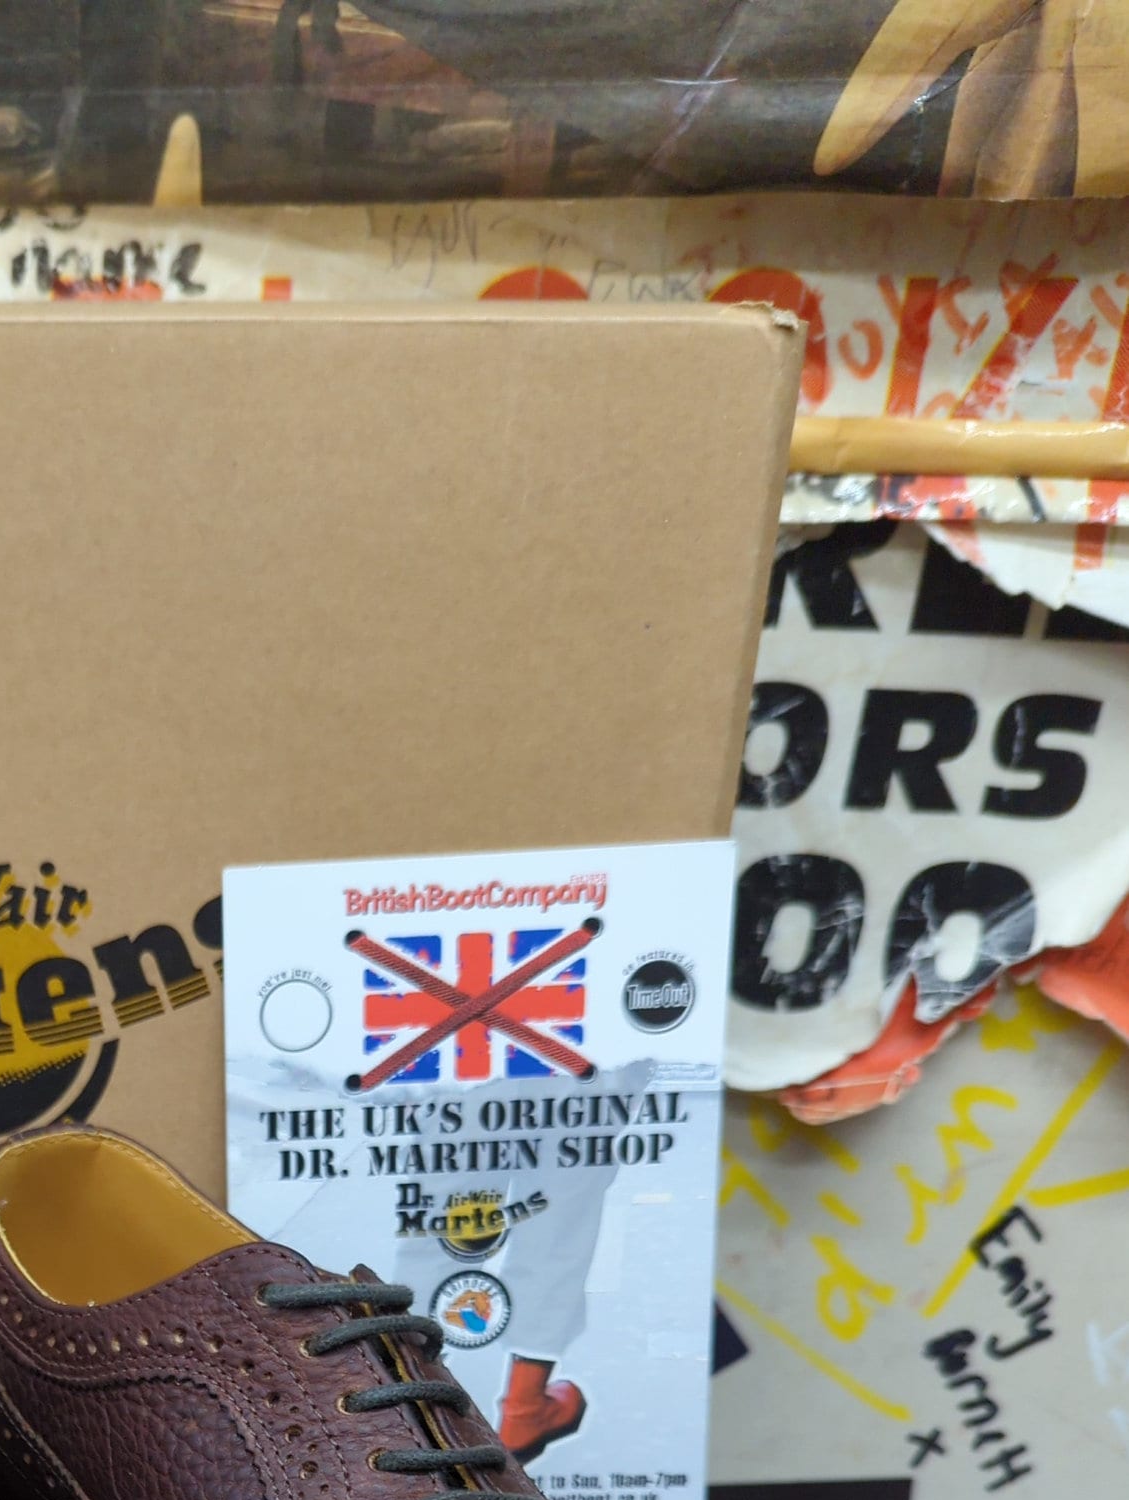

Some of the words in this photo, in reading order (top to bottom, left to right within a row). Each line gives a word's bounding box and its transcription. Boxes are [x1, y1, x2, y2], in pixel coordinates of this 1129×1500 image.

[344, 874, 607, 917] BritishBootCompany
[260, 1106, 345, 1142] THE
[361, 1101, 464, 1138] UK'S
[478, 1091, 689, 1132] ORIGINAL
[278, 1148, 349, 1181] DR.
[368, 1138, 540, 1176] MARTEN
[556, 1132, 675, 1169] SHOP
[396, 1191, 548, 1238] Martens
